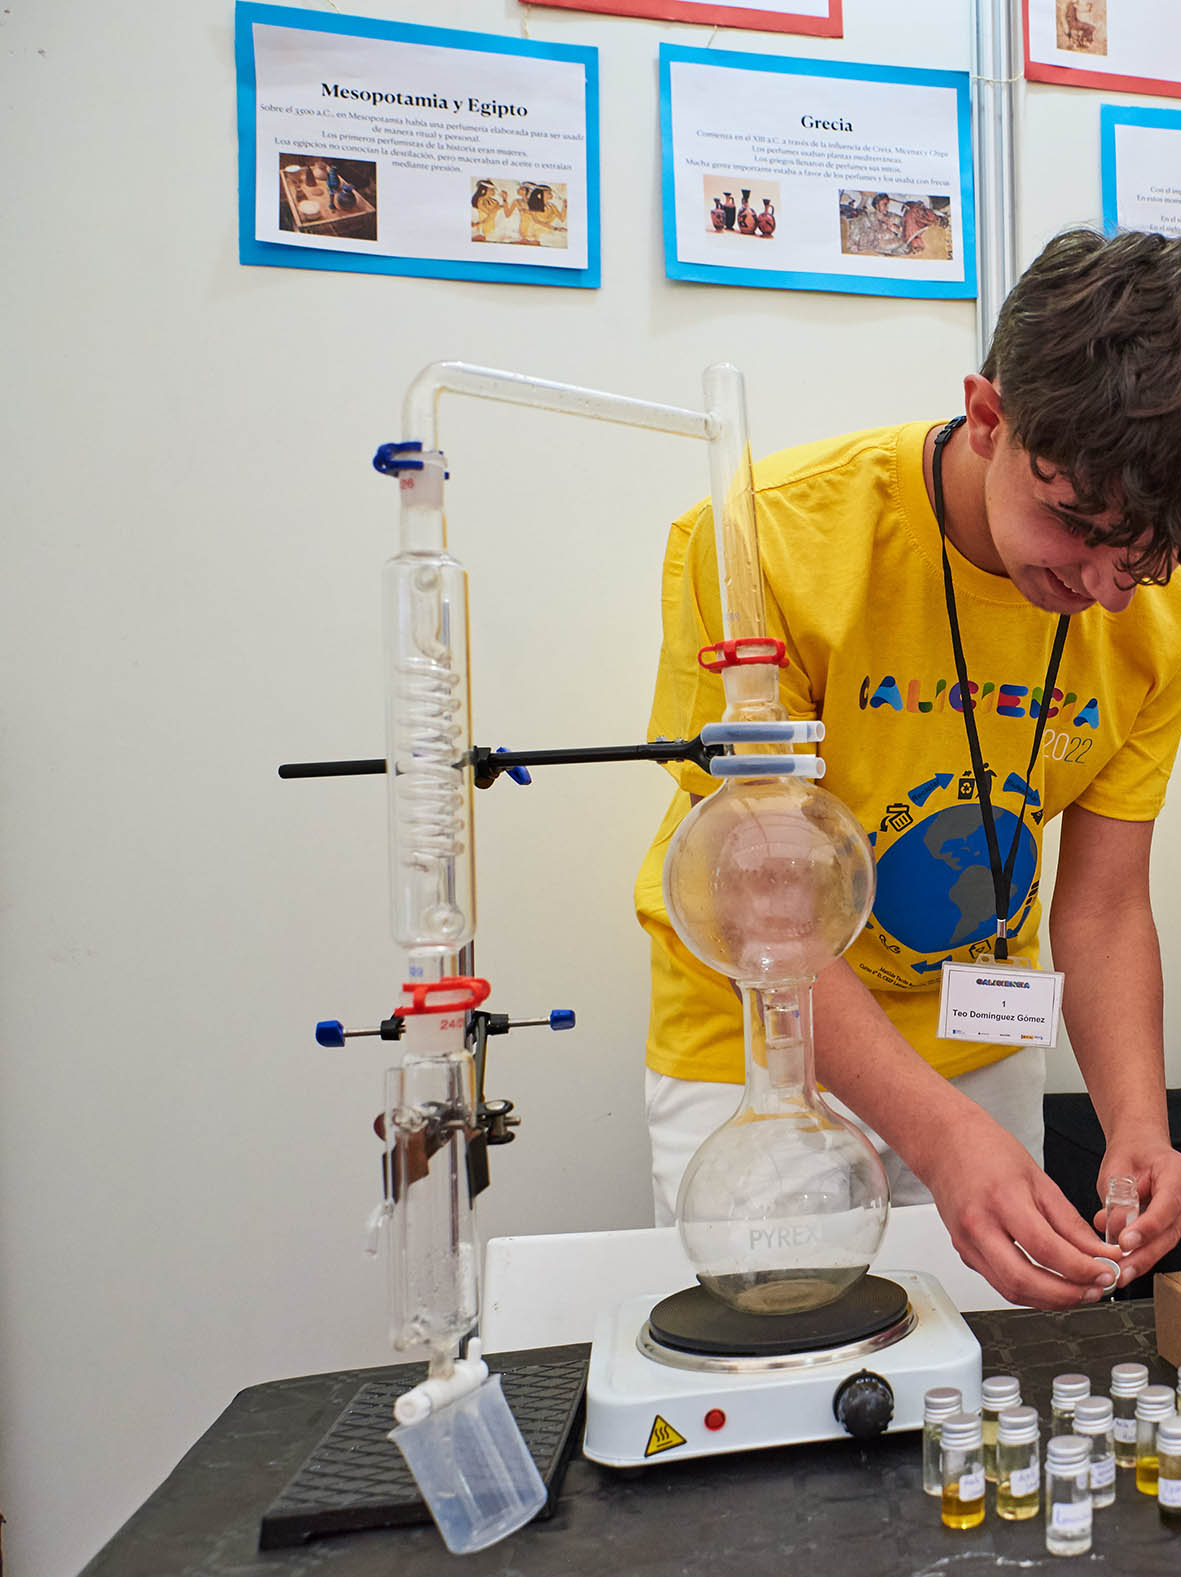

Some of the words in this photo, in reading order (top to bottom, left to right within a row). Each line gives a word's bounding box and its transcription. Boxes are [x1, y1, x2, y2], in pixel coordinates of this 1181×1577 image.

[321, 82, 448, 111] Mesopotamia
[453, 97, 464, 114] y
[468, 98, 528, 119] Egipto
[800, 114, 853, 133] Grecia
[1042, 729, 1093, 764] 2022
[952, 1009, 968, 1018] Teo
[1017, 1014, 1046, 1024] Gómez
[749, 1225, 817, 1250] PYREX
